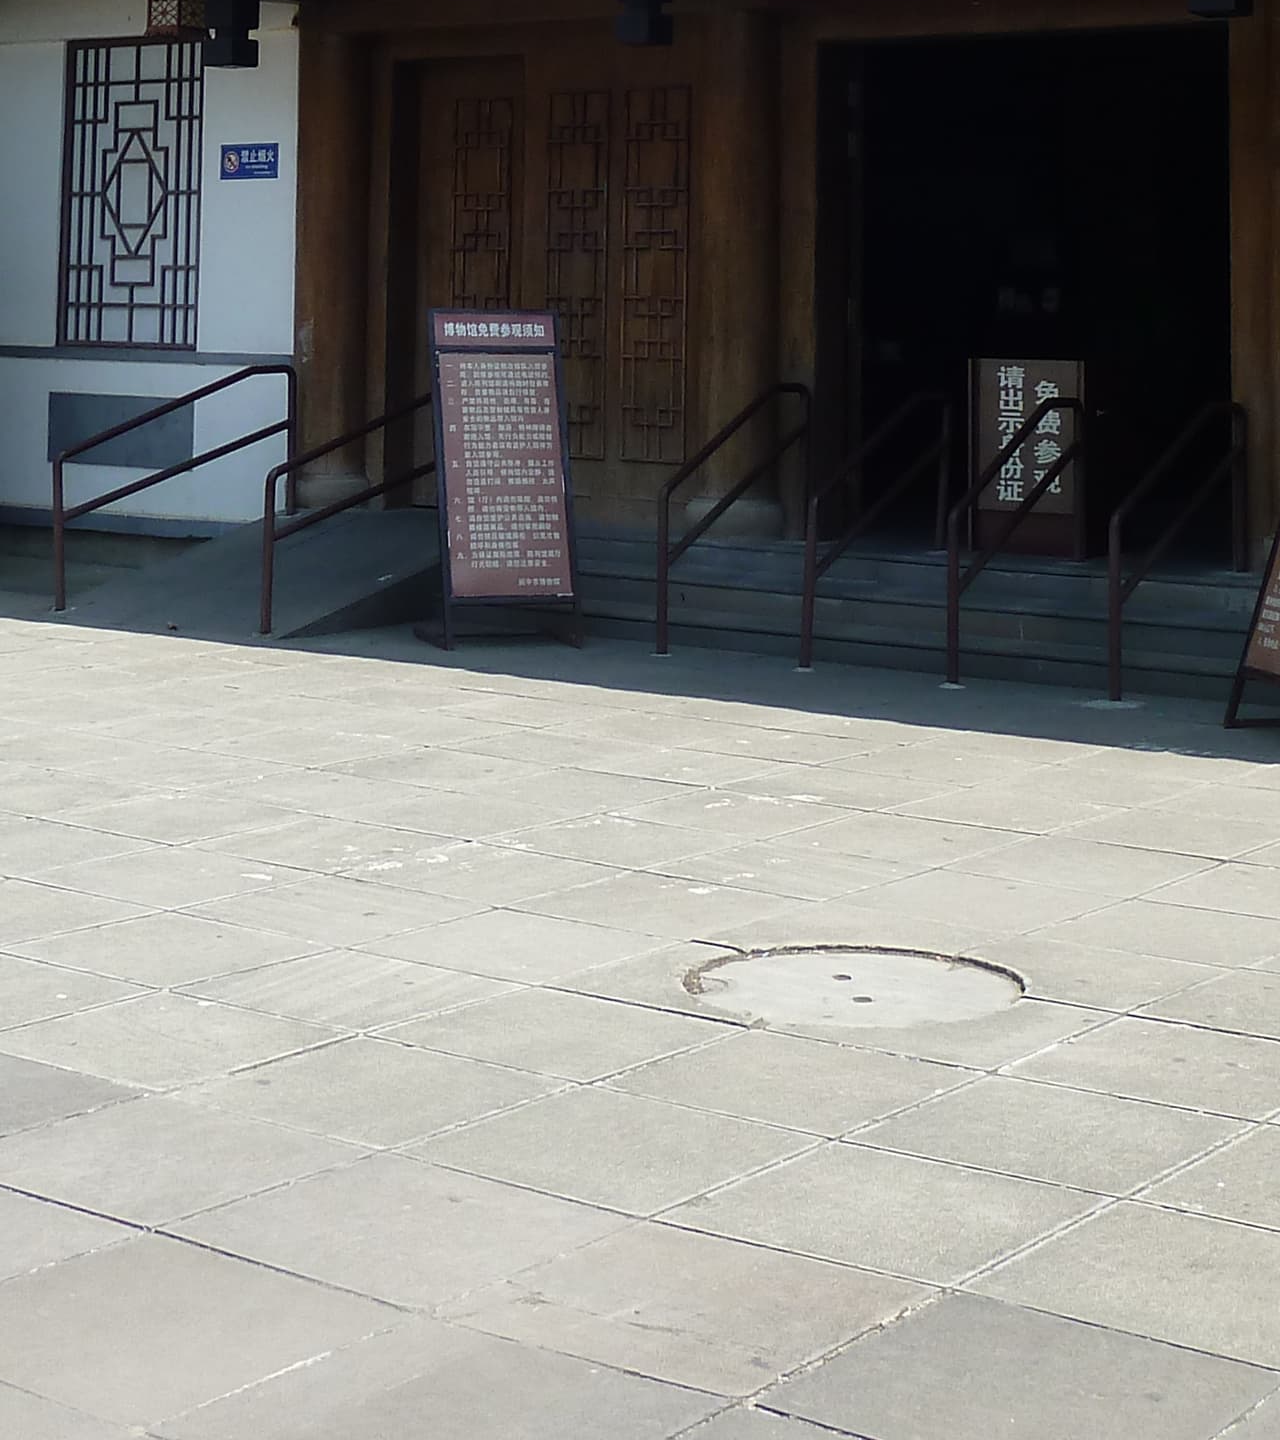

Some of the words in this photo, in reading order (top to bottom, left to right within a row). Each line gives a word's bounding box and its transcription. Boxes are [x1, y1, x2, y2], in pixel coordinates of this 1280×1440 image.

[443, 322, 545, 337] 博物馆免费参观须知
